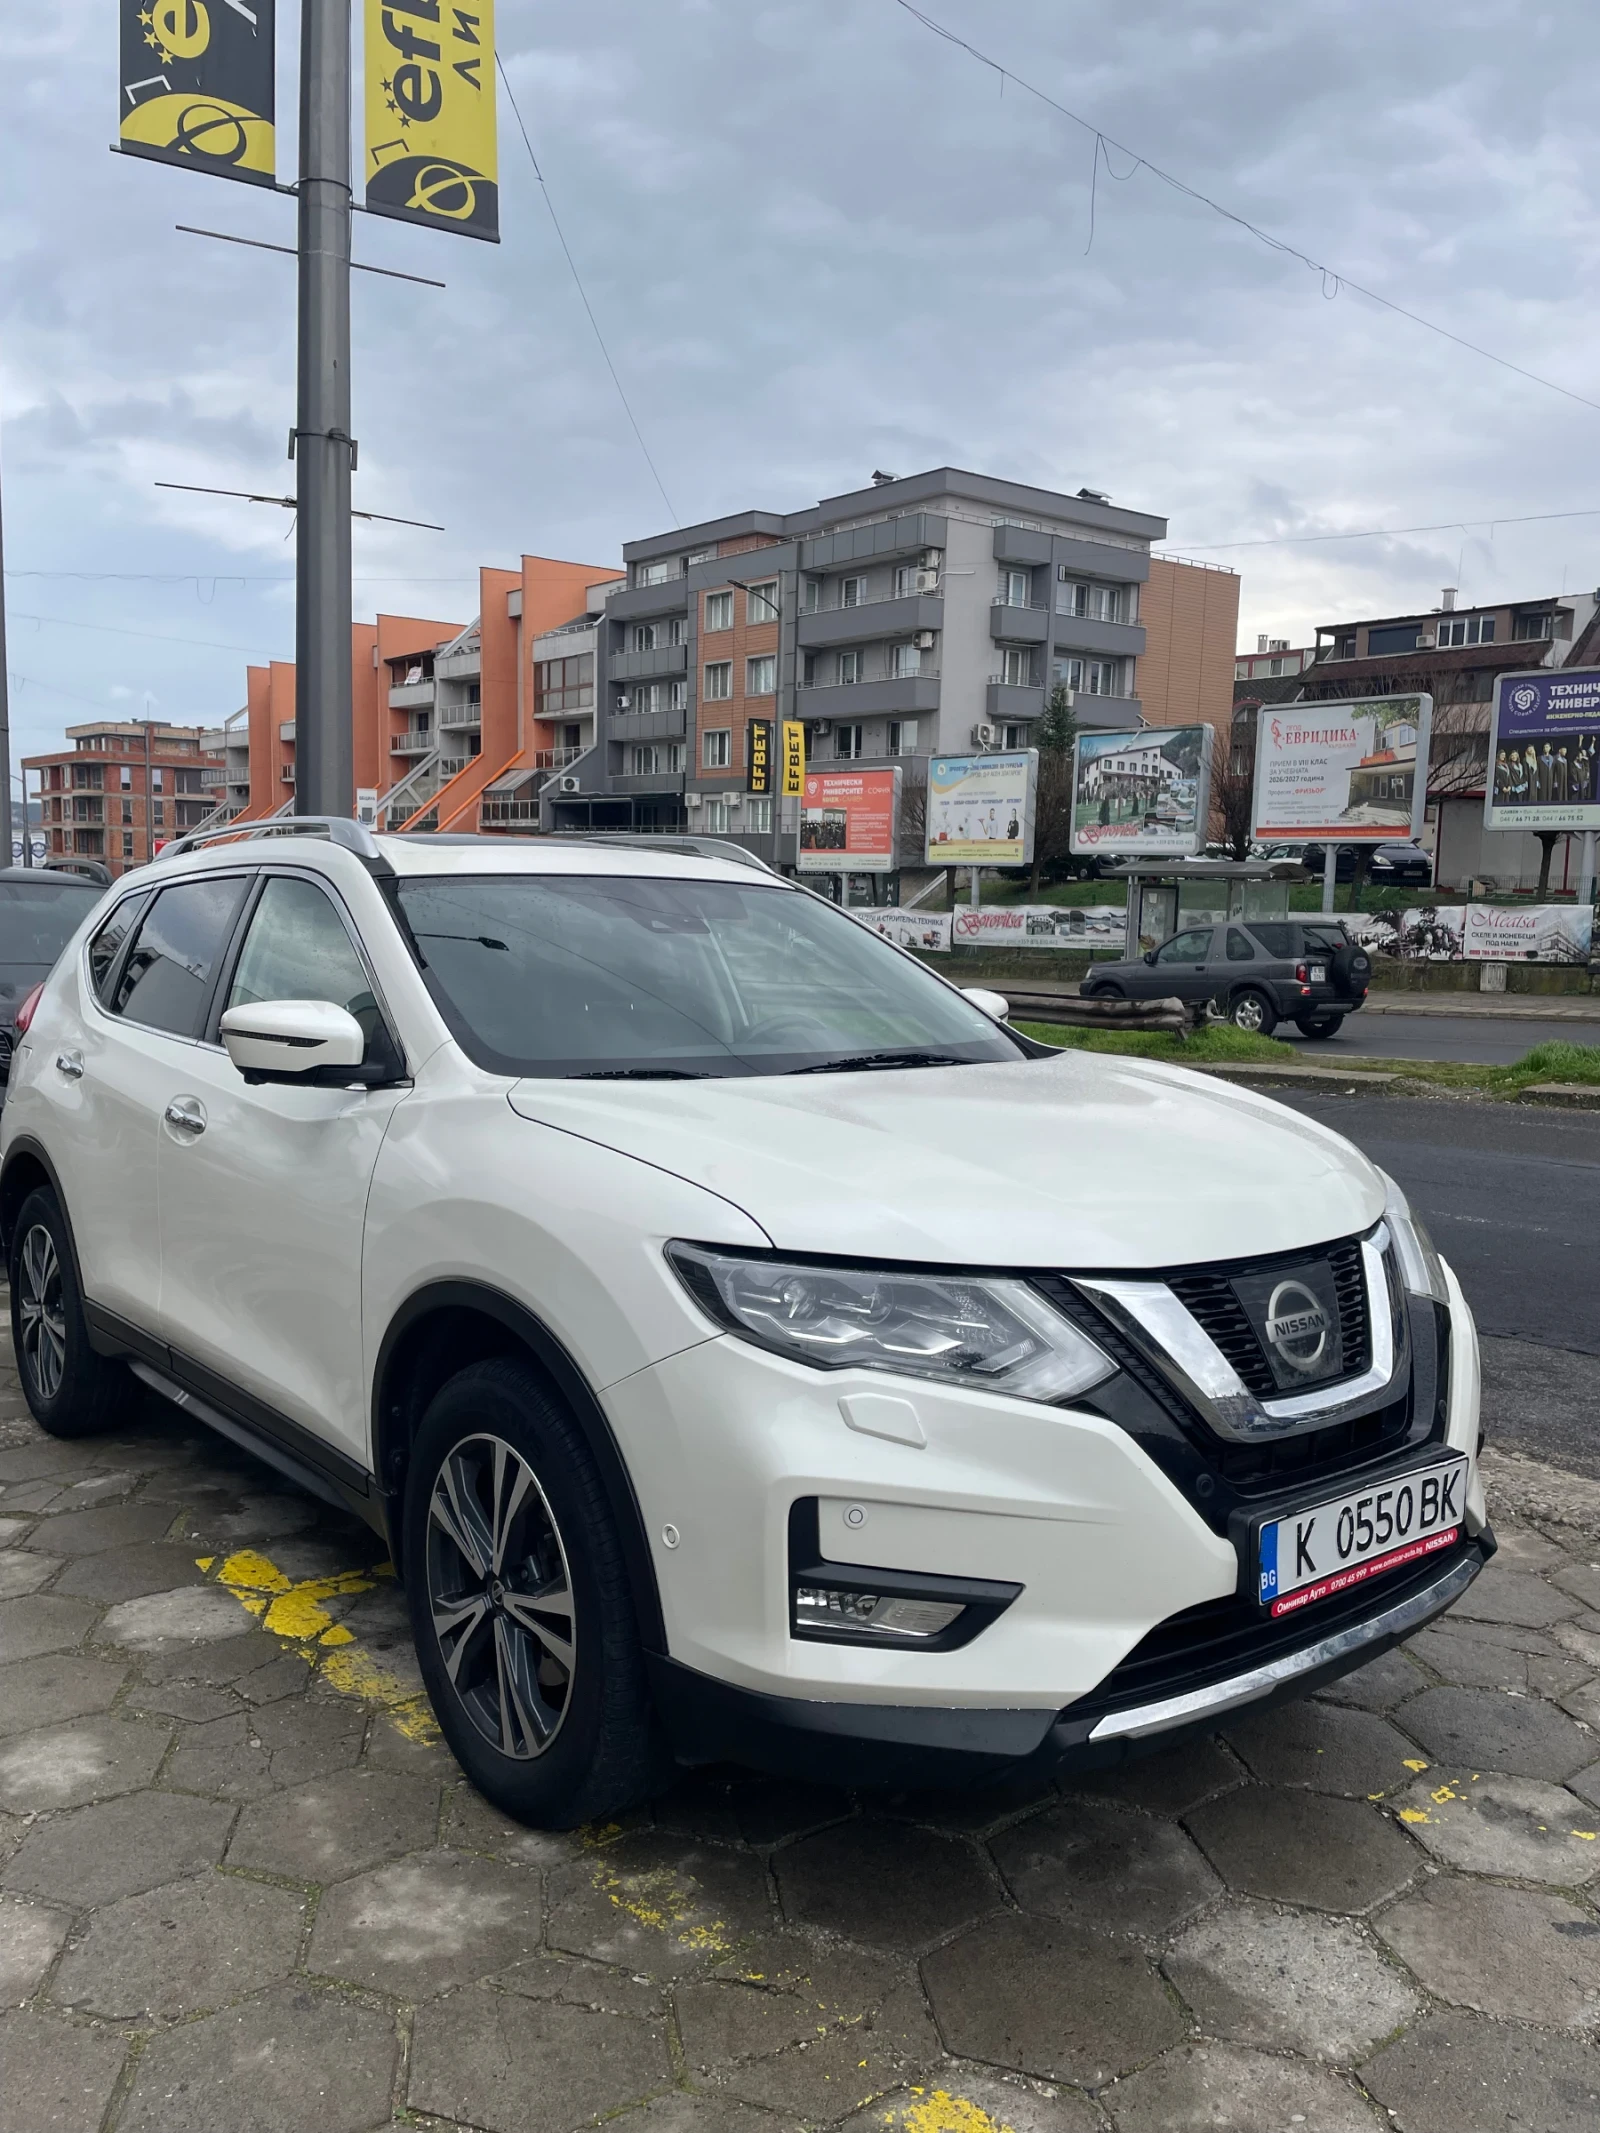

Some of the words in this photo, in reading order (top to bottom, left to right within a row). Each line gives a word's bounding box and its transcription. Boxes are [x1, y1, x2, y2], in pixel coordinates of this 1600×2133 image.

[752, 723, 766, 790] EFBET
[788, 727, 799, 791] EFBET
[822, 787, 864, 795] УНИВЕРСИТЕТ
[867, 786, 890, 795] СОФИЯ
[823, 778, 863, 787] ТЕХНИЧЕСКИ
[1269, 775, 1300, 783] 2026/2027
[881, 915, 916, 924] СТРОИТЕЛНА
[917, 917, 944, 926] ТЕХНИКА
[955, 910, 1025, 936] Borovitsa
[1274, 1313, 1325, 1337] NISSAN
[1296, 1517, 1317, 1579] K
[1336, 1485, 1413, 1560] 0550
[1420, 1468, 1461, 1529] BK
[1260, 1569, 1277, 1590] BG
[1276, 1593, 1309, 1614] Омникар
[1309, 1585, 1326, 1601] Ауто
[1330, 1576, 1347, 1591] 0700
[1347, 1572, 1356, 1585] 45
[1355, 1567, 1367, 1580] 999
[1370, 1546, 1423, 1573] www.omnicar-auto.bg
[1425, 1532, 1454, 1552] NISSAN
